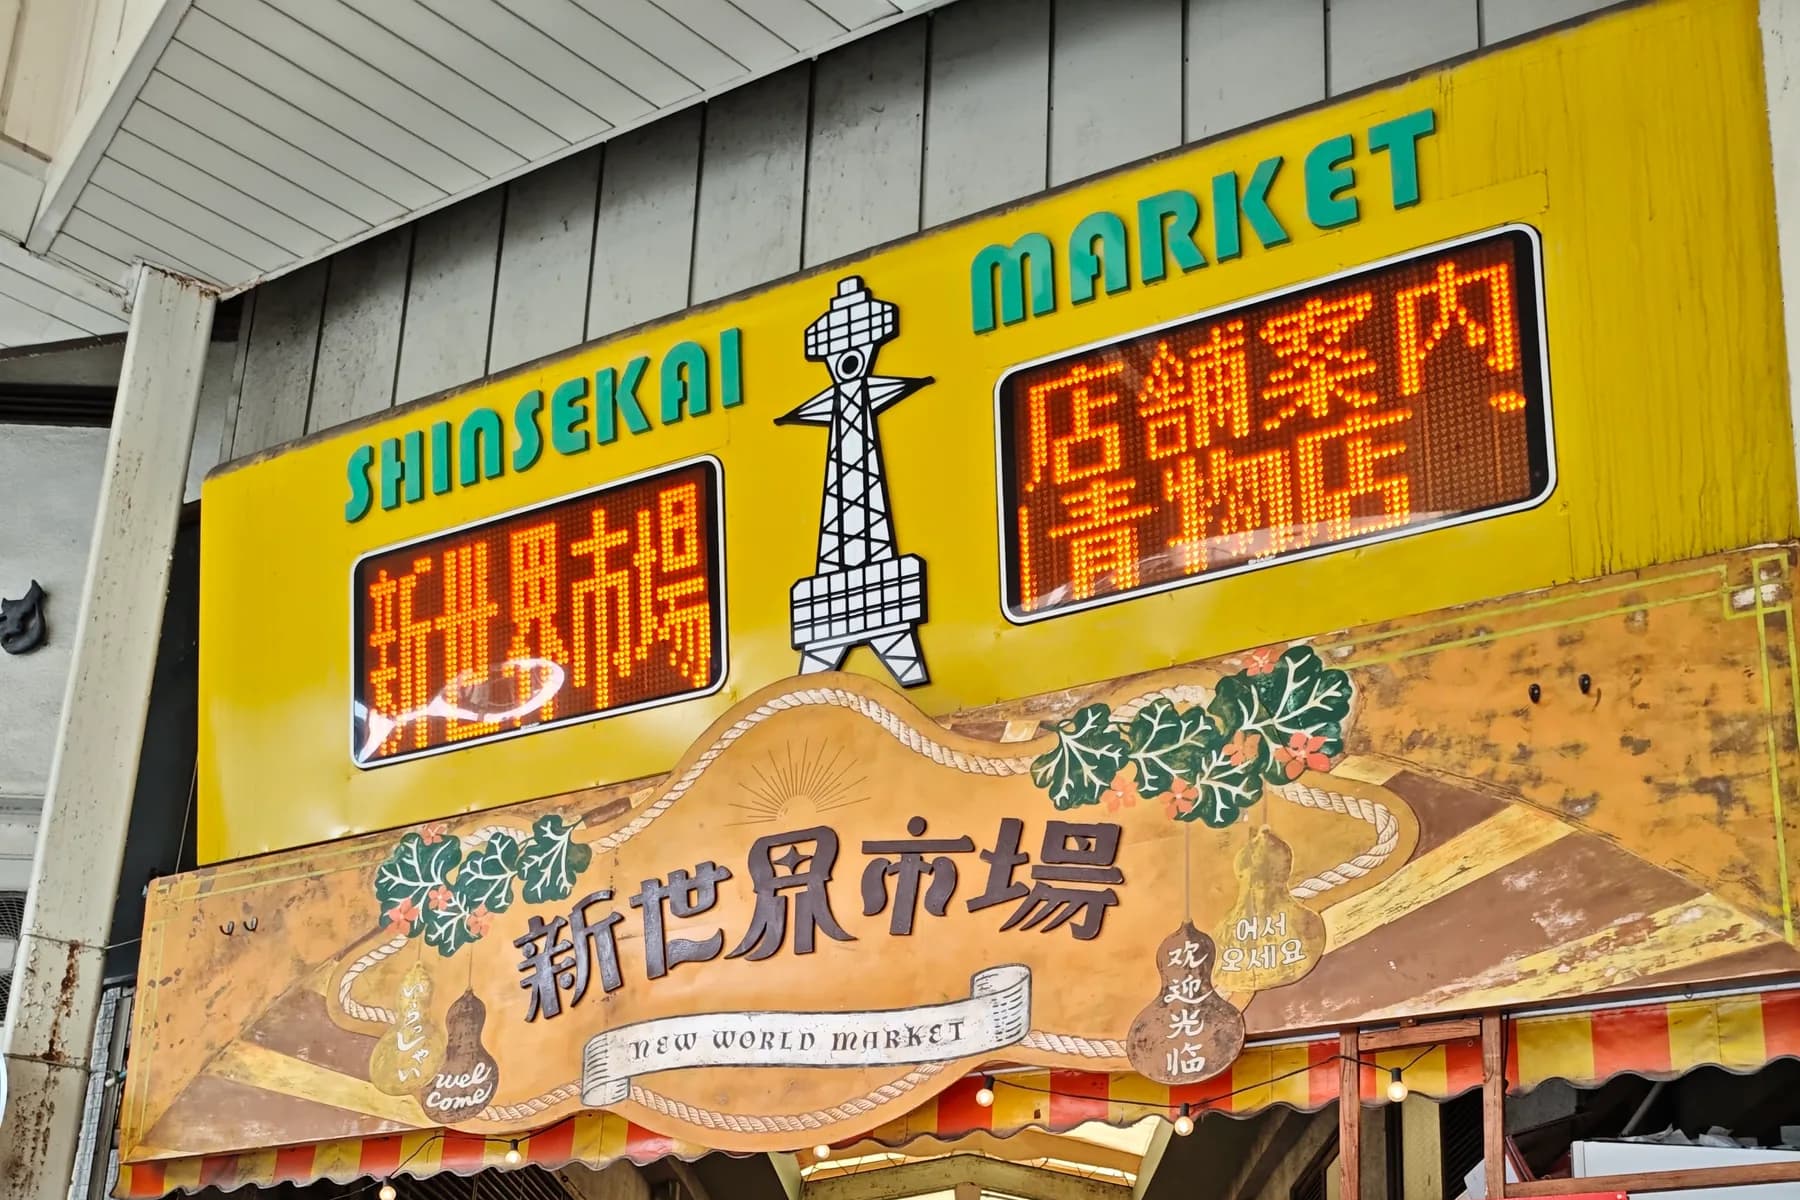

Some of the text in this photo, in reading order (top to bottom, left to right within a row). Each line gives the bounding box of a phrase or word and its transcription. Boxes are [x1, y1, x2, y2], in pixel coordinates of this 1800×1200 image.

[971, 108, 1437, 335] MARKET
[345, 328, 744, 523] SHINSEKAI
[1024, 262, 1517, 493] 店舗案内
[368, 482, 712, 757] 新世界市場
[513, 816, 1125, 1024] 新世界市場
[1163, 940, 1214, 1076] 欢迎光临
[1221, 939, 1306, 972] 오세요
[1235, 912, 1287, 942] 어서
[630, 1020, 966, 1060] NEW WORLD MARKET
